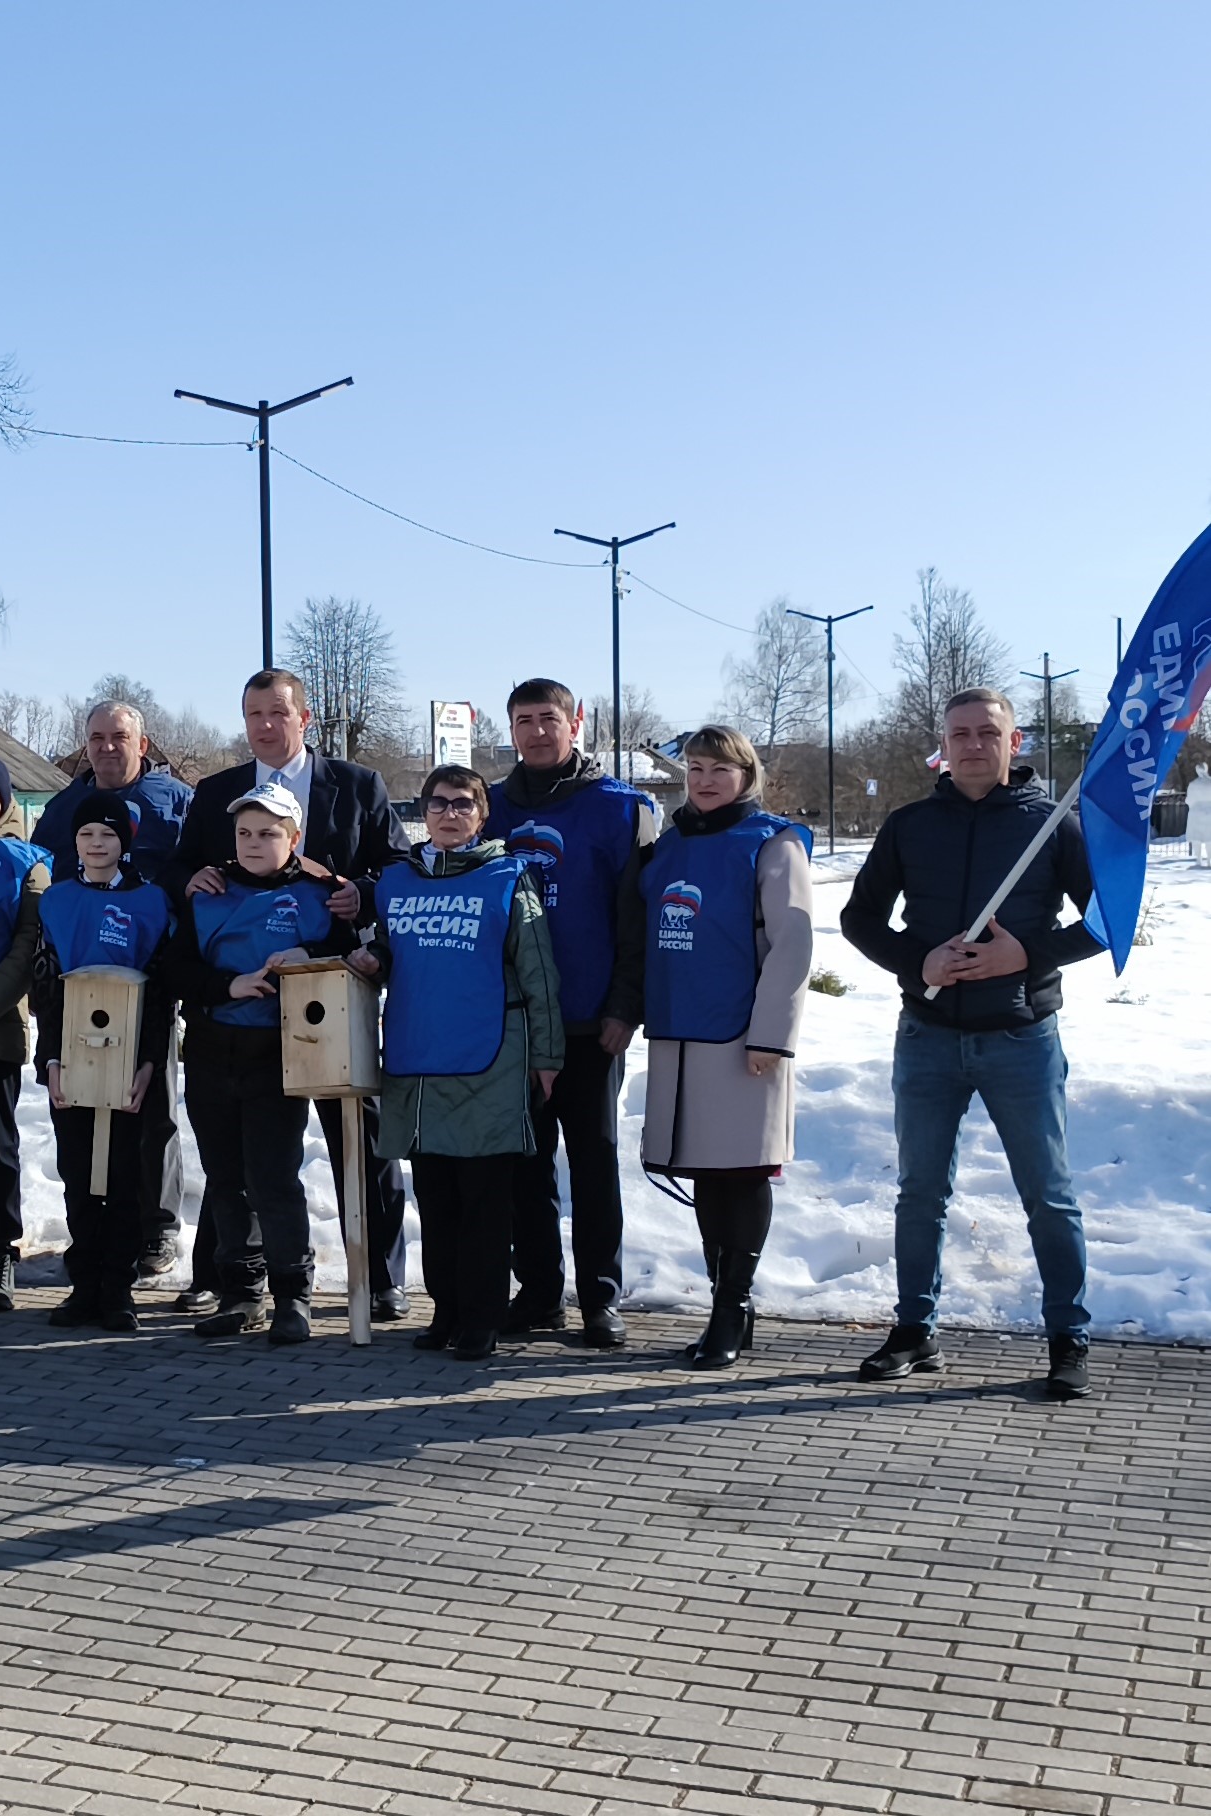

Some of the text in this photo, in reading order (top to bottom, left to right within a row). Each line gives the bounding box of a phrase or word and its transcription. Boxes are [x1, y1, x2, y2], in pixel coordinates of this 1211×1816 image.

[388, 895, 484, 916] ЕДИНАЯ
[387, 915, 480, 939] РОССИЯ
[418, 936, 475, 951] tver.er.ru
[658, 939, 693, 951] РОССИЯ
